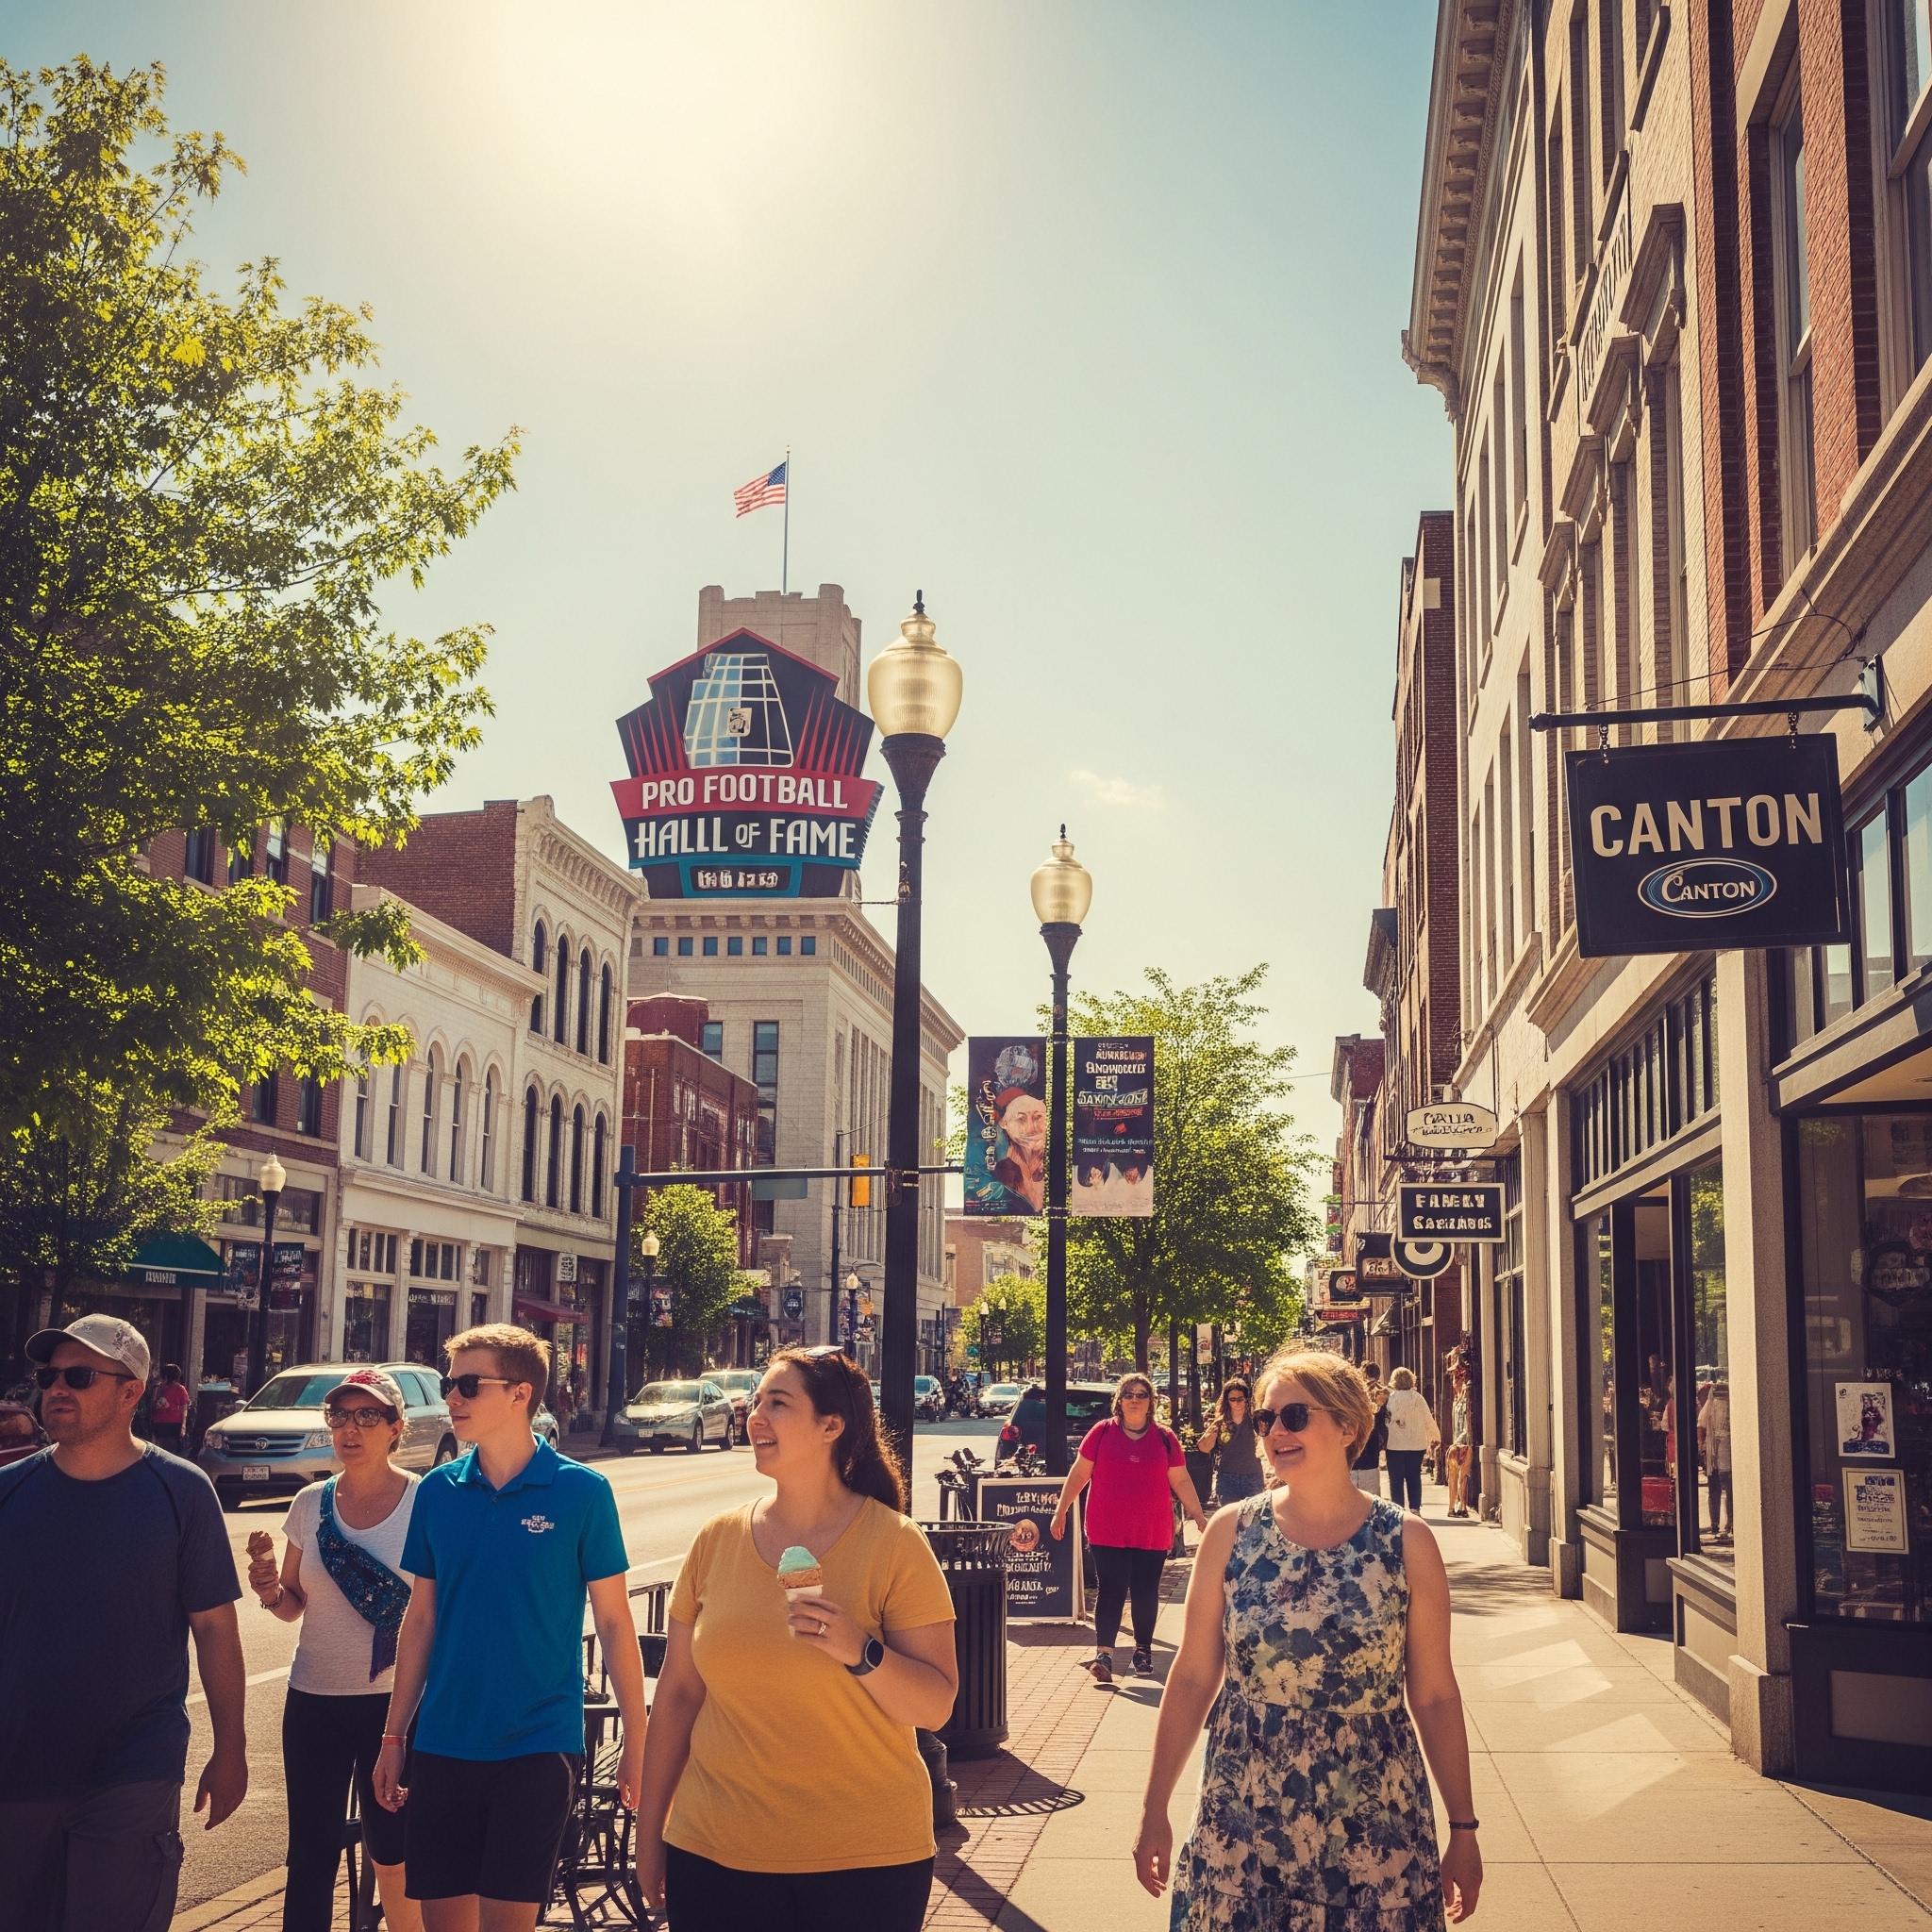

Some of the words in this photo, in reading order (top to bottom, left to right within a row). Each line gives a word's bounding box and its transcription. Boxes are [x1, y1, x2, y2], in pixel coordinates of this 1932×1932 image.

[641, 776, 695, 810] PRO
[703, 774, 848, 809] FOOTBALL
[634, 817, 729, 858] HALLL
[735, 823, 761, 849] OF
[770, 818, 856, 859] FAME
[1590, 792, 1823, 858] CANTON
